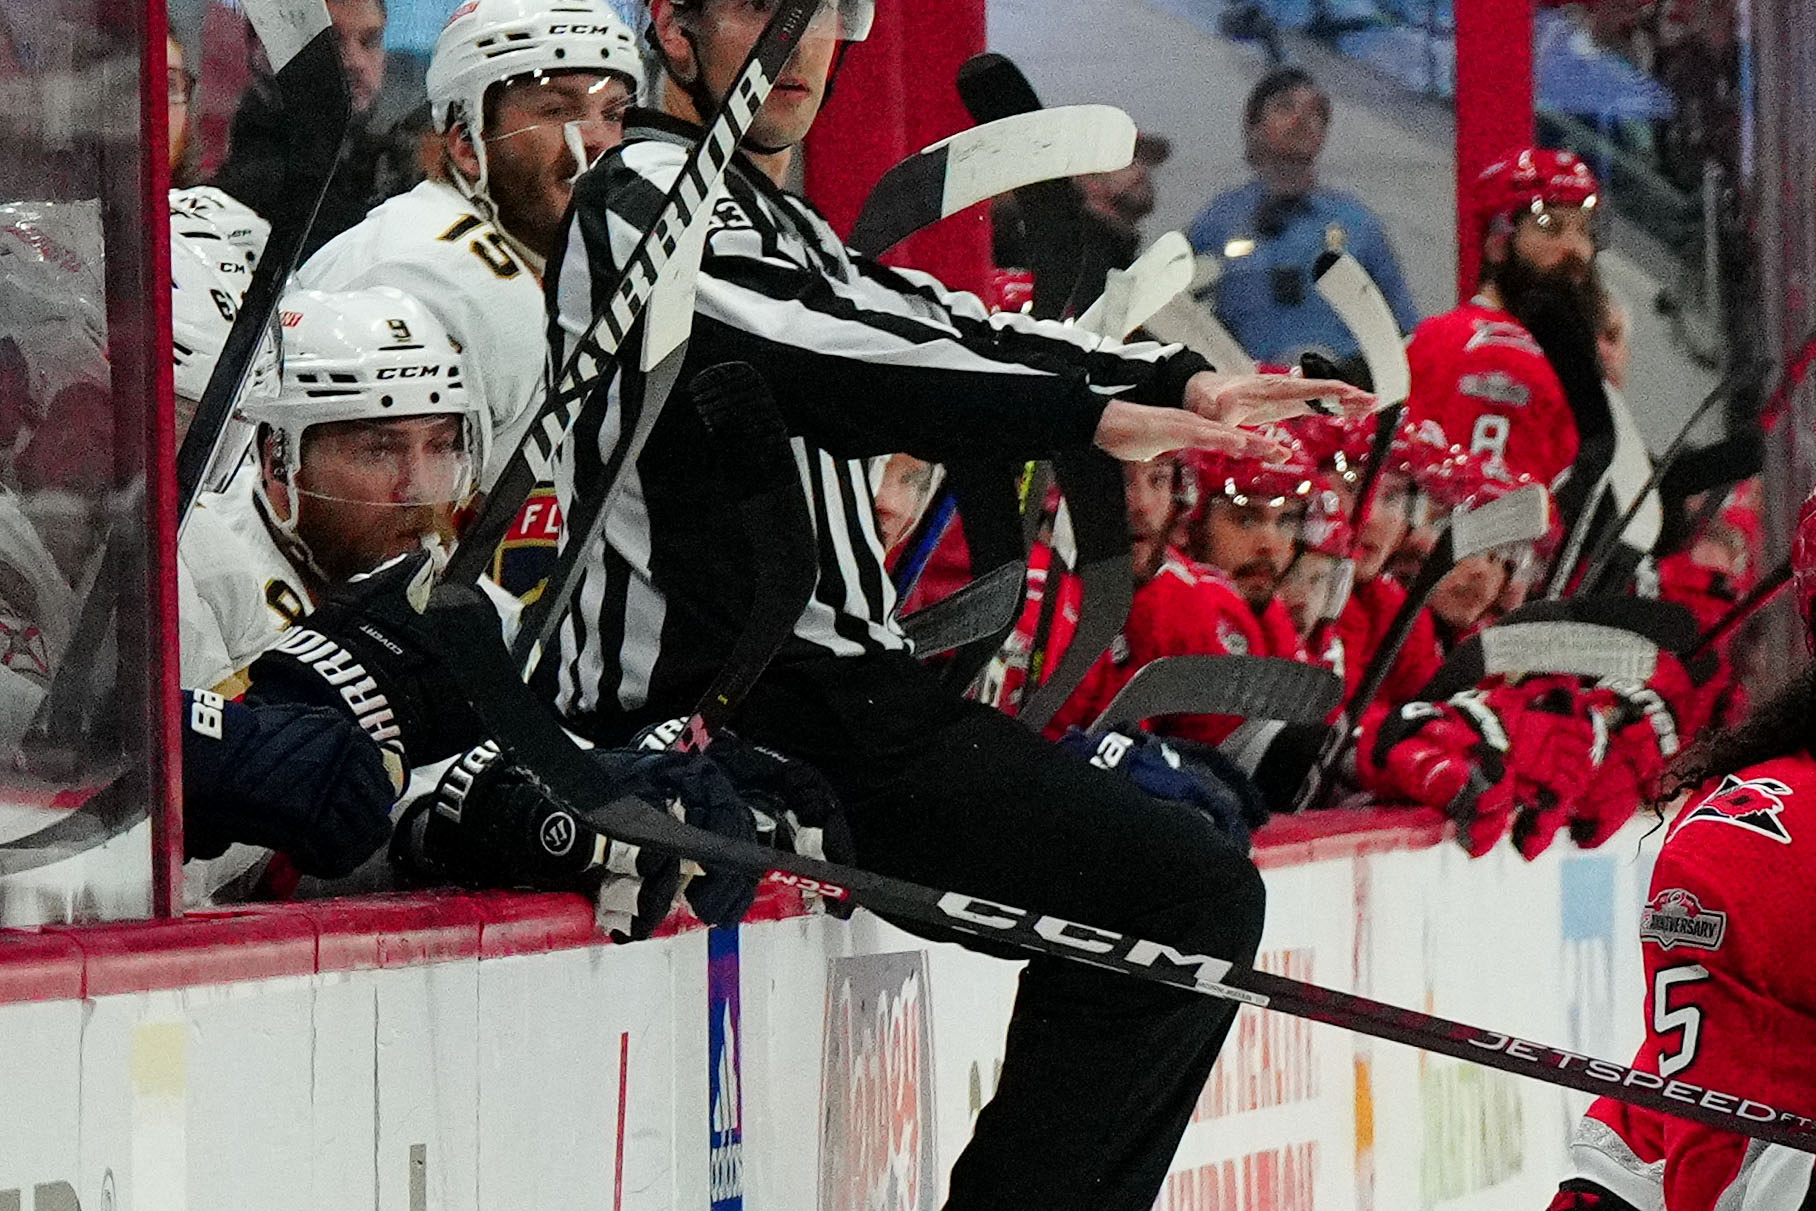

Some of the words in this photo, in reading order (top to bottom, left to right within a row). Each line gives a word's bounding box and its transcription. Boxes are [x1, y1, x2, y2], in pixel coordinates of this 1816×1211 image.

[548, 24, 609, 36] CCM
[522, 57, 774, 484] WARRIOR
[375, 365, 441, 380] CCM
[936, 890, 1235, 986] CCM
[1653, 963, 1711, 1079] 5
[1466, 1032, 1778, 1124] JETSPEED
